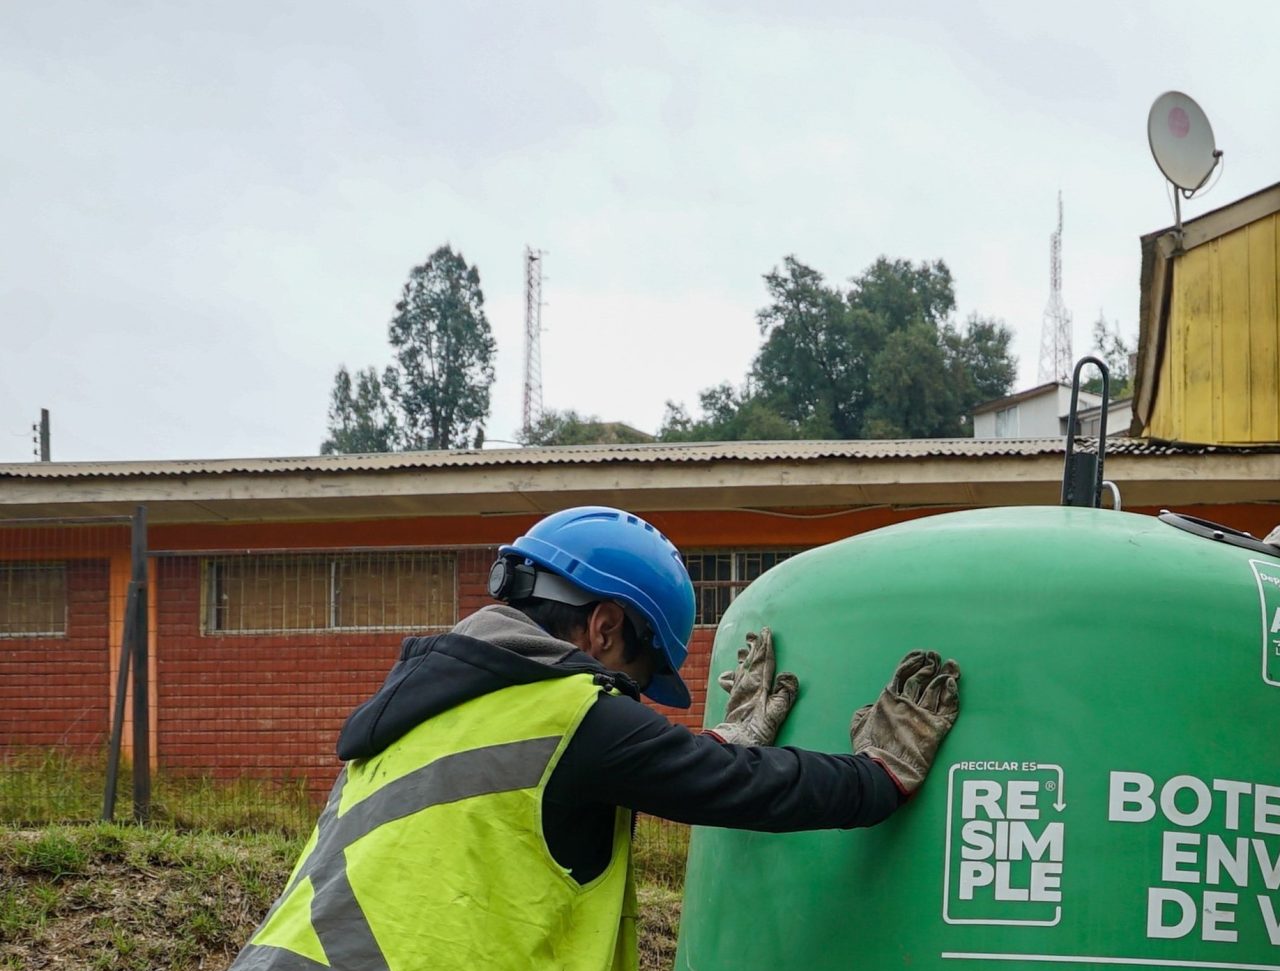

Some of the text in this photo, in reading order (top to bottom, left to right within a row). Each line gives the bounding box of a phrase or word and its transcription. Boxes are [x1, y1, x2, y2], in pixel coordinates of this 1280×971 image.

[960, 761, 1037, 771] RECICLAR ES
[961, 780, 1040, 820] RE
[961, 820, 1065, 862] SIM
[958, 861, 1063, 902] PLE
[1146, 887, 1239, 943] DE
